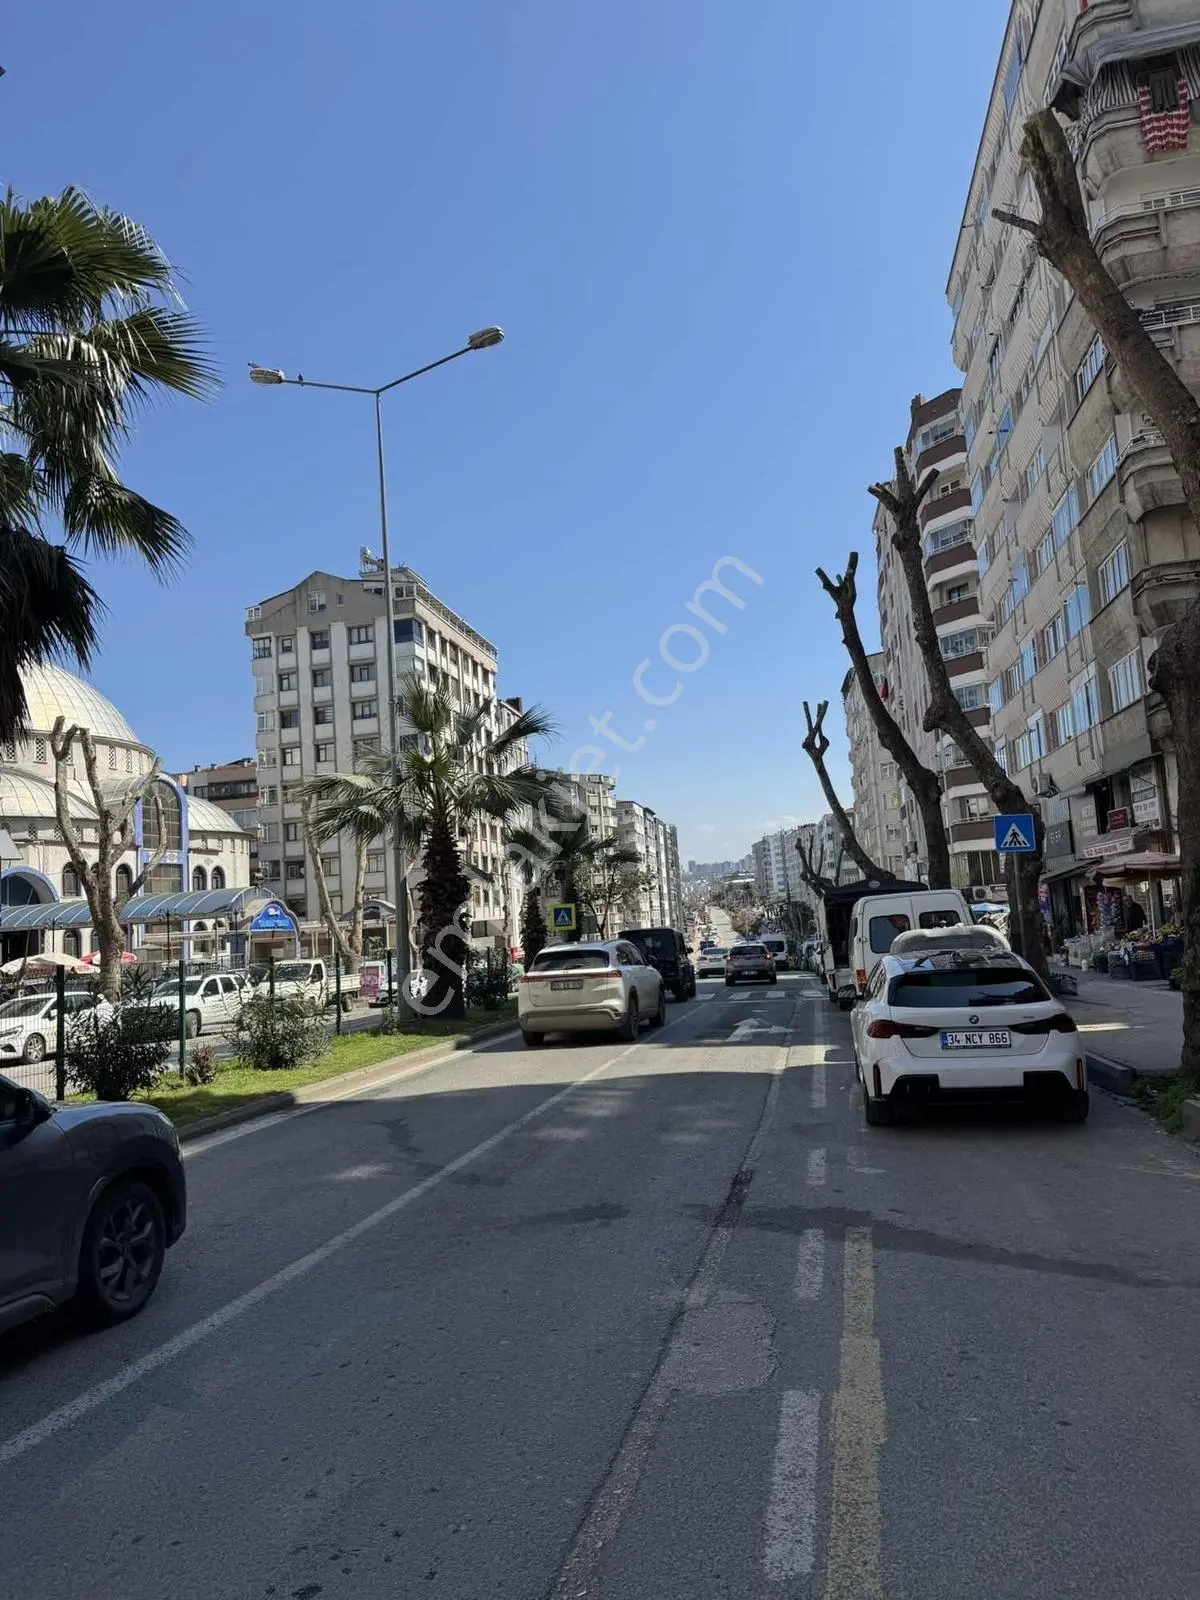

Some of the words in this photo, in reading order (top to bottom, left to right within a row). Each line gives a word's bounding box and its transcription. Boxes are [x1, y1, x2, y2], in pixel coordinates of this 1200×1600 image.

[948, 1034, 960, 1045] 34
[965, 1033, 983, 1044] NCY
[989, 1032, 1008, 1044] 866
